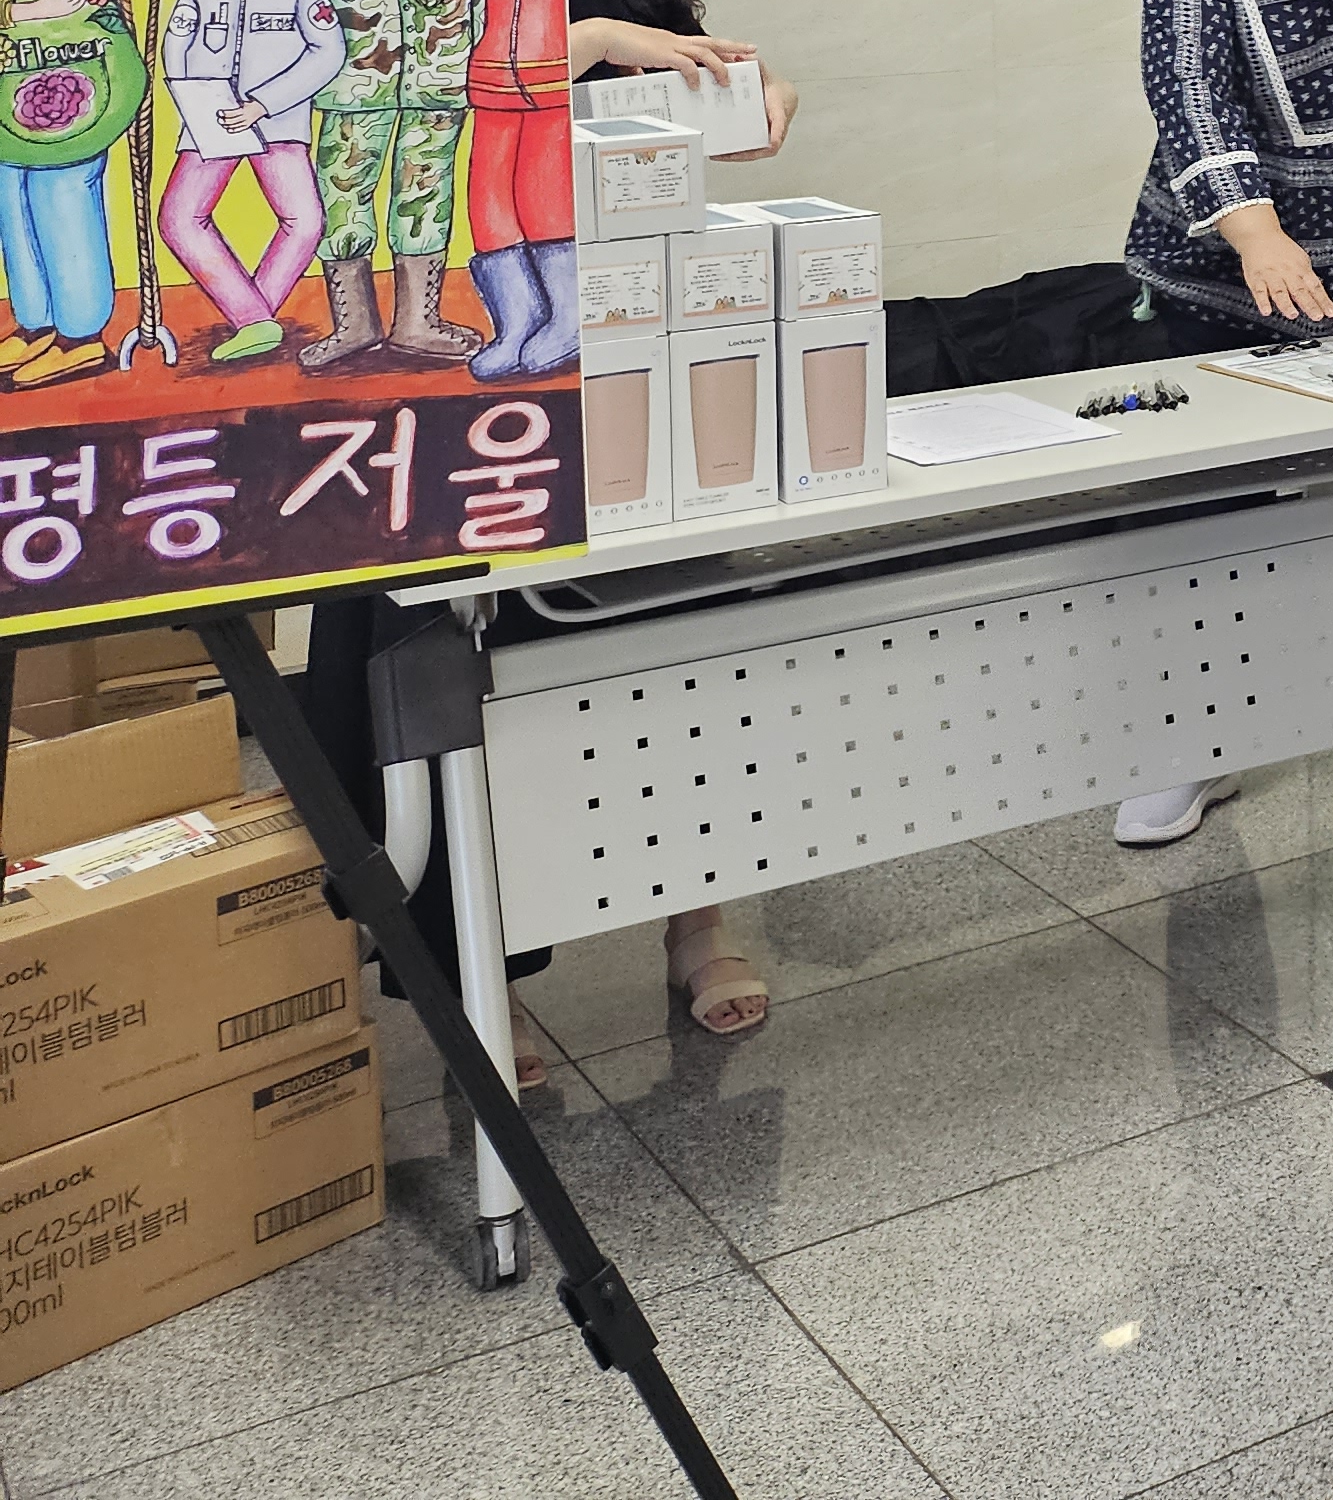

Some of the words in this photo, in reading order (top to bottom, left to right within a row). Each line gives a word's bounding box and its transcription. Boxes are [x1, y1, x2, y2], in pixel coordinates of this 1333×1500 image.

[16, 35, 112, 71] Flower
[0, 427, 236, 583] 평등
[279, 401, 562, 552] 저울
[0, 1197, 189, 1300] 지테이블텀블러
